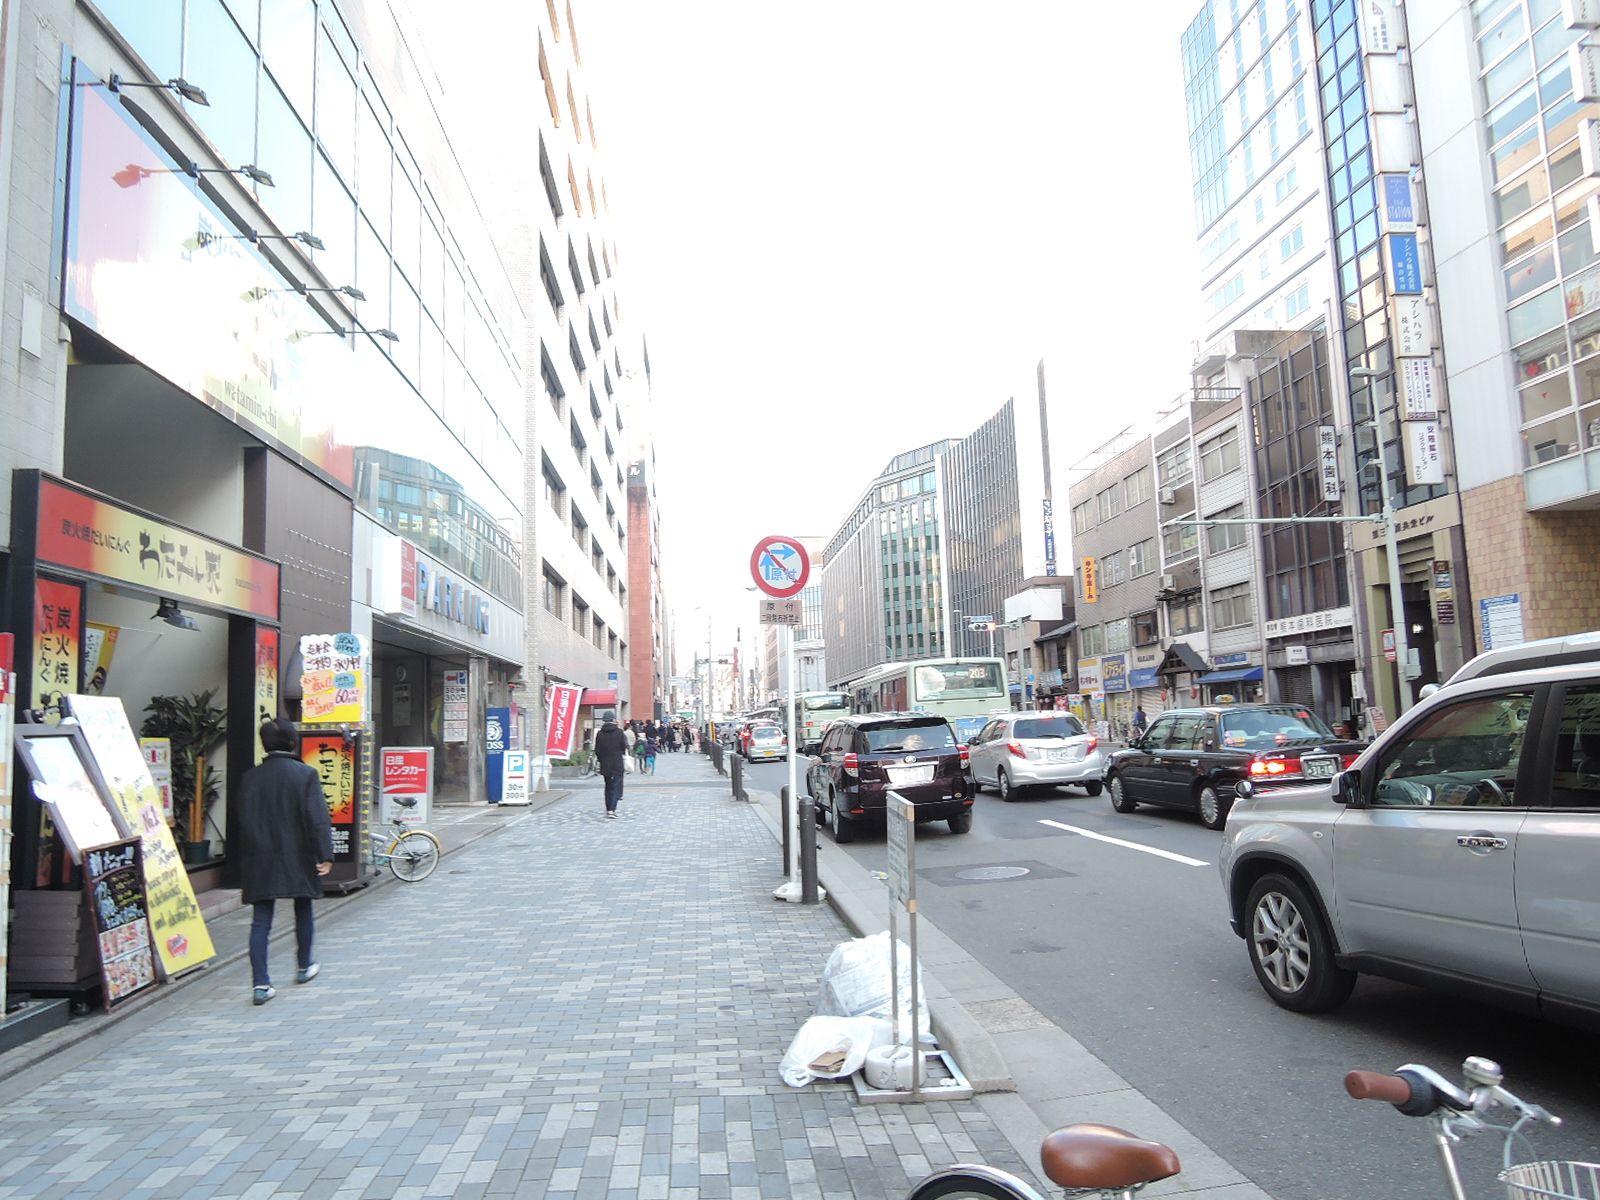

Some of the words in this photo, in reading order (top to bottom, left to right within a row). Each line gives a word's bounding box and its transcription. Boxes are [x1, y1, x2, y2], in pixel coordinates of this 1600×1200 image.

[1410, 299, 1423, 341] アシハラ
[1320, 431, 1337, 495] 熊本歯科
[61, 518, 131, 555] 炭火焼だいにんぐ
[772, 567, 797, 581] 原付
[761, 613, 801, 623] 二段階右折禁止
[39, 603, 54, 684] だいにんぐ
[55, 606, 71, 684] 炭火焼
[969, 667, 985, 679] 203
[385, 756, 404, 766] 日産
[385, 765, 426, 776] レンタカー
[508, 783, 524, 791] 30分
